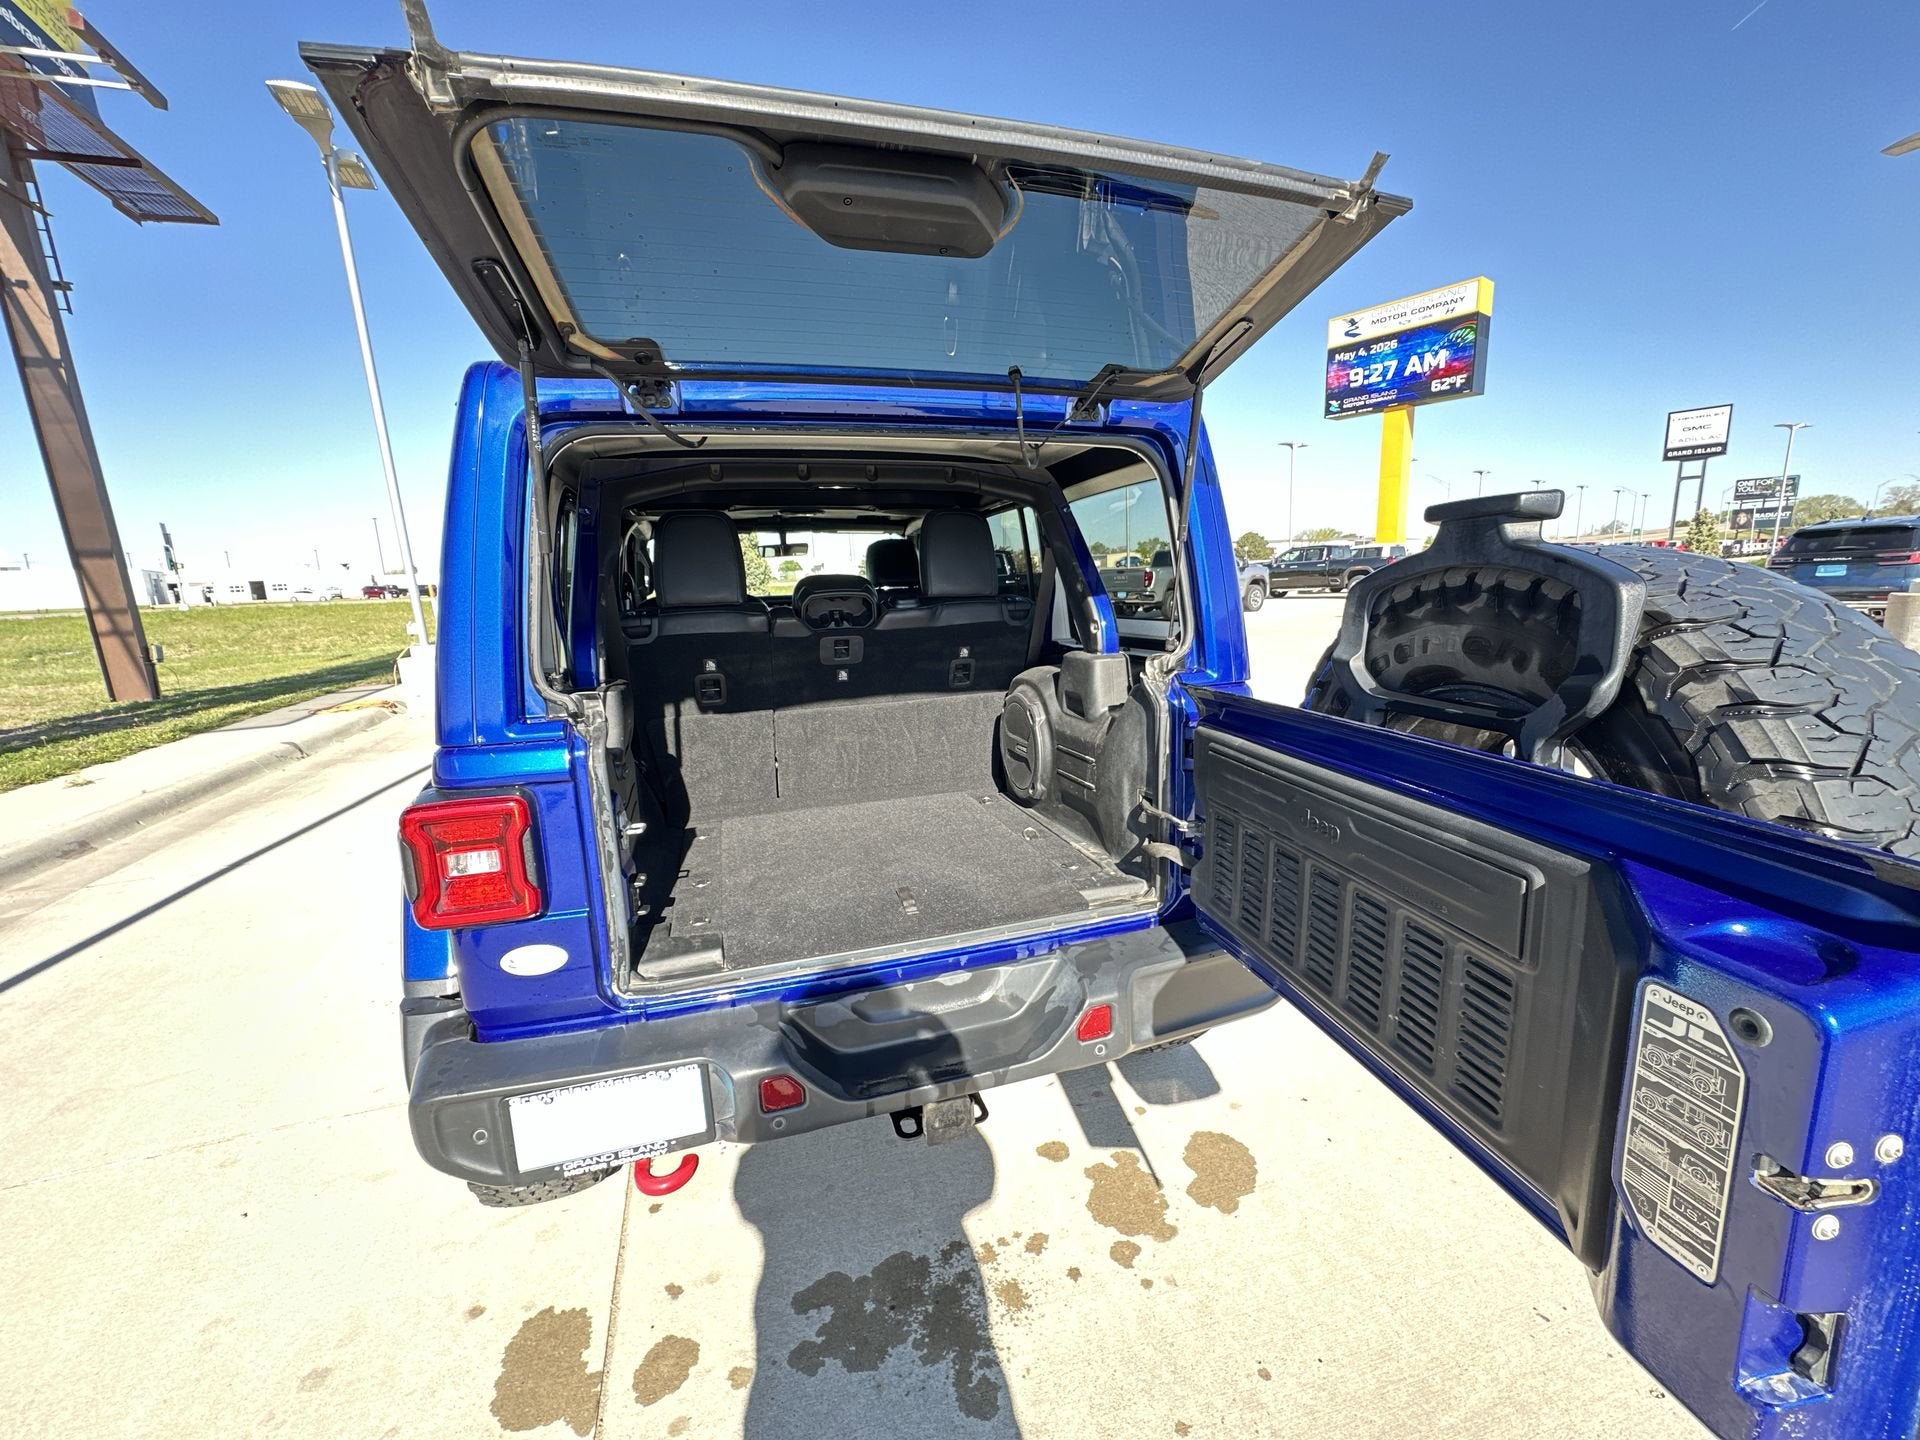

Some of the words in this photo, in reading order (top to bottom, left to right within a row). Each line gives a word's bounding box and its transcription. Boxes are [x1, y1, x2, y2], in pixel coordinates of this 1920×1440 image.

[1371, 312, 1407, 325] MOTOR
[1411, 296, 1465, 315] COMPANY
[1335, 351, 1356, 362] May
[1358, 347, 1367, 357] 4,
[1370, 339, 1398, 354] 2026
[1350, 360, 1398, 387] 9:27
[1404, 349, 1447, 376] AM
[1343, 394, 1369, 404] GRAND
[1370, 389, 1397, 398] ISLAND
[1366, 395, 1397, 404] COMPANY
[1682, 424, 1712, 432] GMC
[1667, 449, 1692, 457] GRAND
[1694, 446, 1722, 454] ISLAND
[1300, 807, 1341, 844] Jeep
[1663, 995, 1694, 1016] Jeep
[1647, 1016, 1728, 1056] JL
[562, 1154, 616, 1171] GRAND
[618, 1140, 669, 1158] ISLAND
[563, 1163, 608, 1178] MOTOR
[609, 1148, 668, 1168] COMPANY
[1673, 1198, 1716, 1236] U.S.A.
